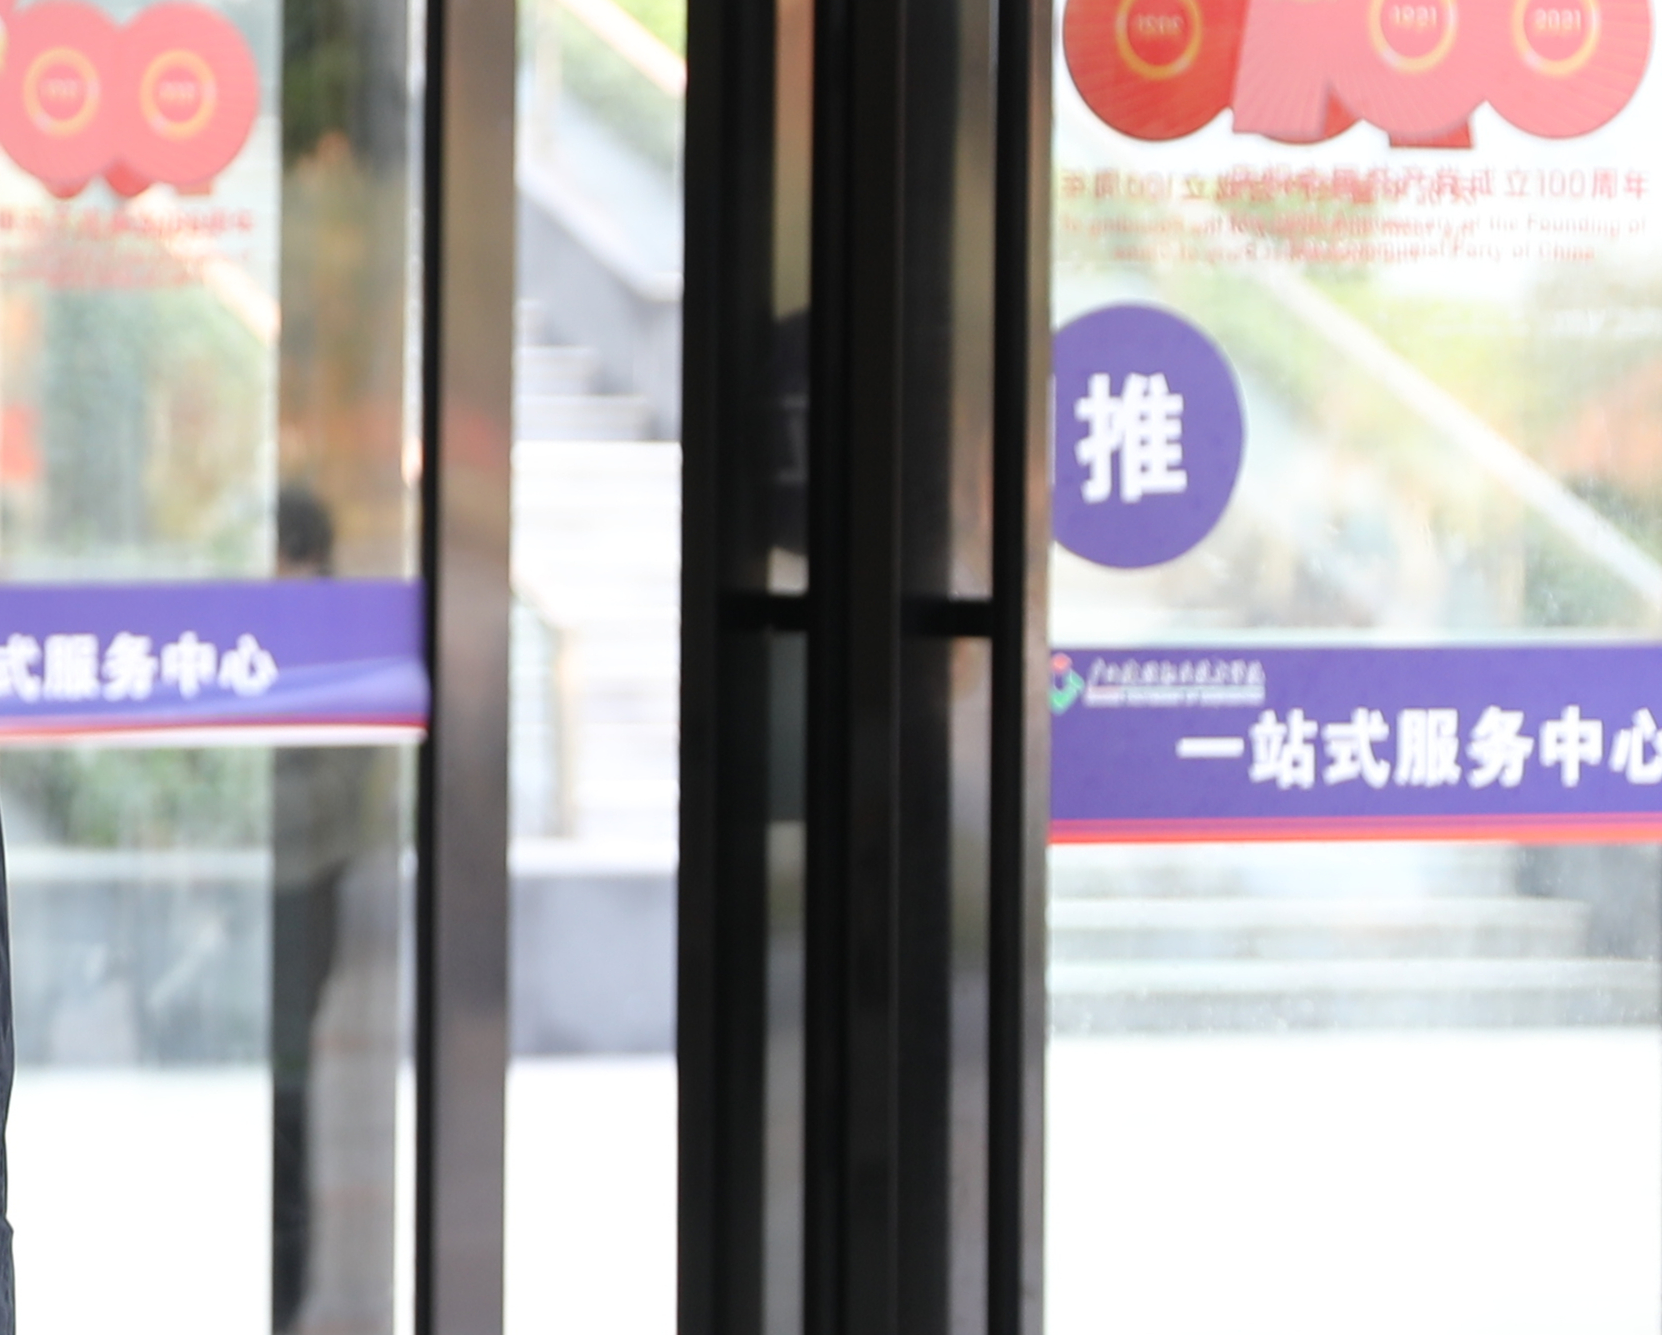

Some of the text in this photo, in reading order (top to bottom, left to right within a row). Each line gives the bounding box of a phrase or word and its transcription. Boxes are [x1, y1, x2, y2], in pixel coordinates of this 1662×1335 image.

[1074, 371, 1189, 504] 推
[1175, 705, 1662, 791] 一站式服务中心
